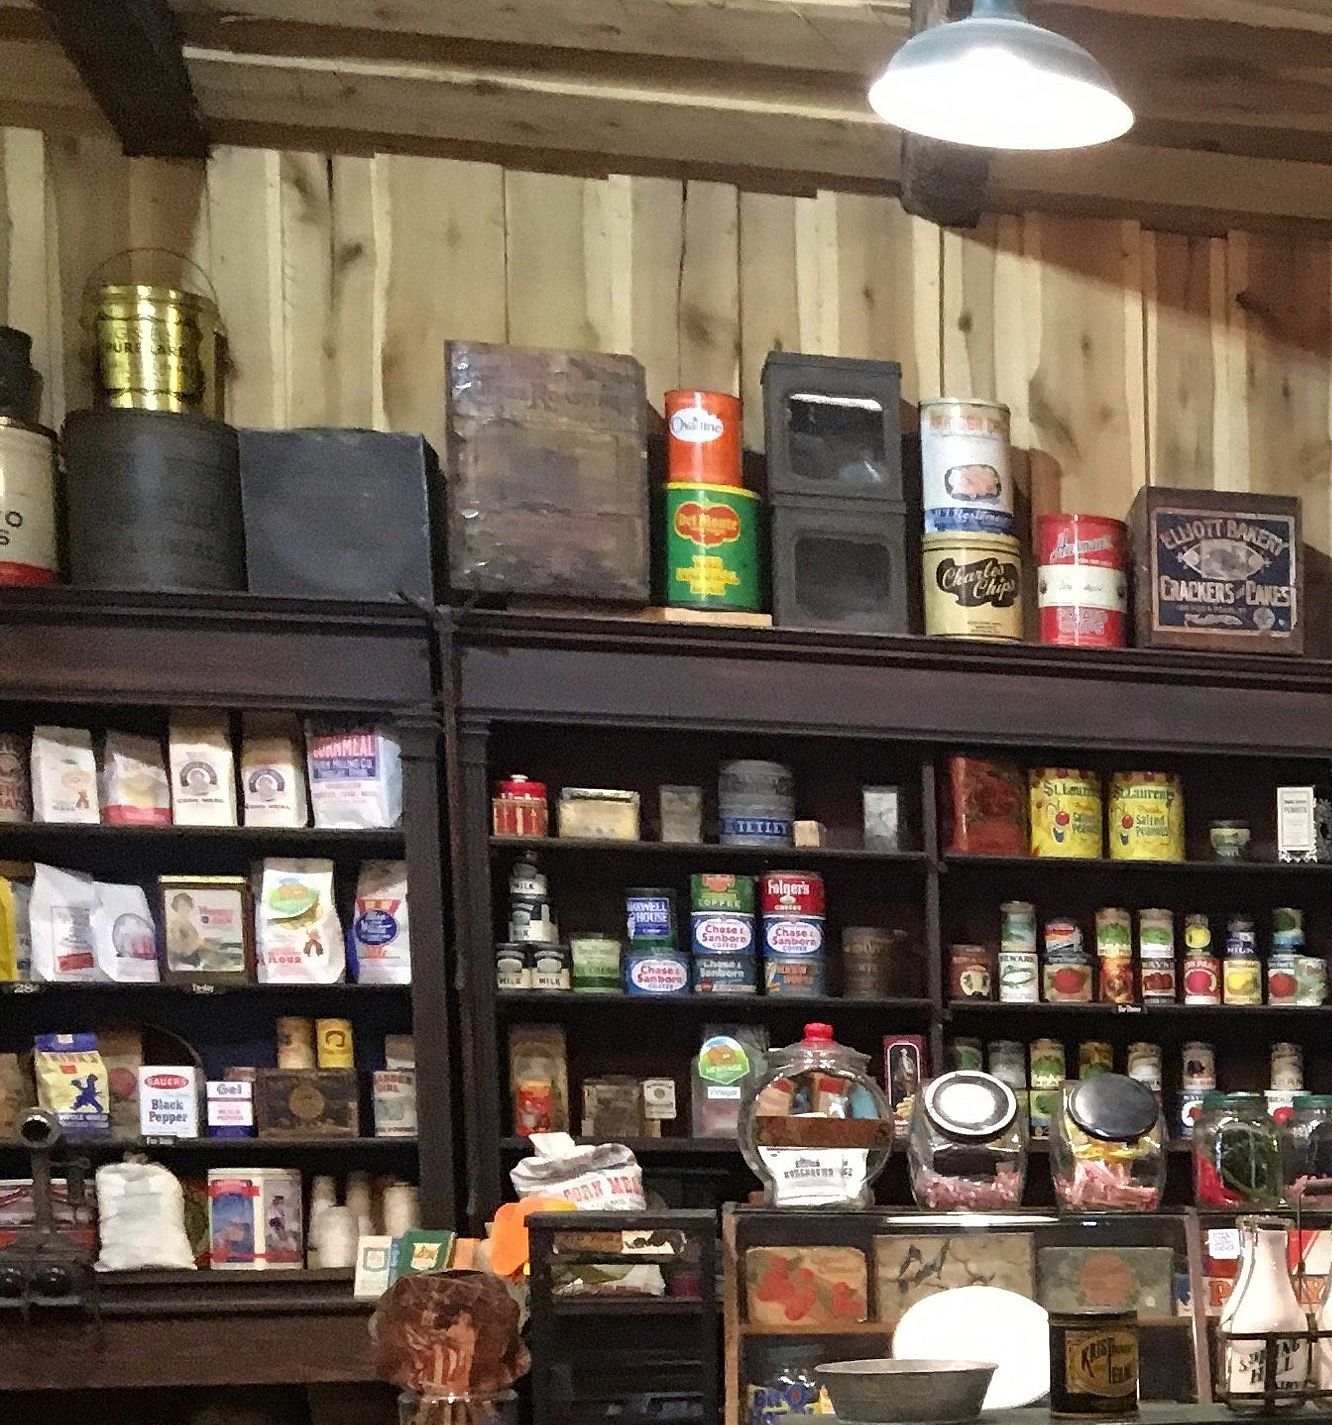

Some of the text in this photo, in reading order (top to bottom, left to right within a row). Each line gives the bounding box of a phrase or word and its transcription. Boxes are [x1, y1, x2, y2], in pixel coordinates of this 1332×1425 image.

[1227, 519, 1290, 556] BAKERY
[972, 575, 1017, 602] Chips
[1160, 575, 1292, 608] CRACKERS CAKES
[736, 820, 790, 835] TETLEY
[636, 911, 668, 923] HOUSE
[705, 924, 738, 935] Chase
[775, 927, 807, 938] Chase
[702, 932, 747, 943] Sanborn
[772, 937, 817, 947] Sanborn
[641, 965, 673, 975] Chase
[151, 1098, 183, 1110] Black
[149, 1110, 188, 1124] Pepper
[563, 1173, 643, 1202] CORN MEA
